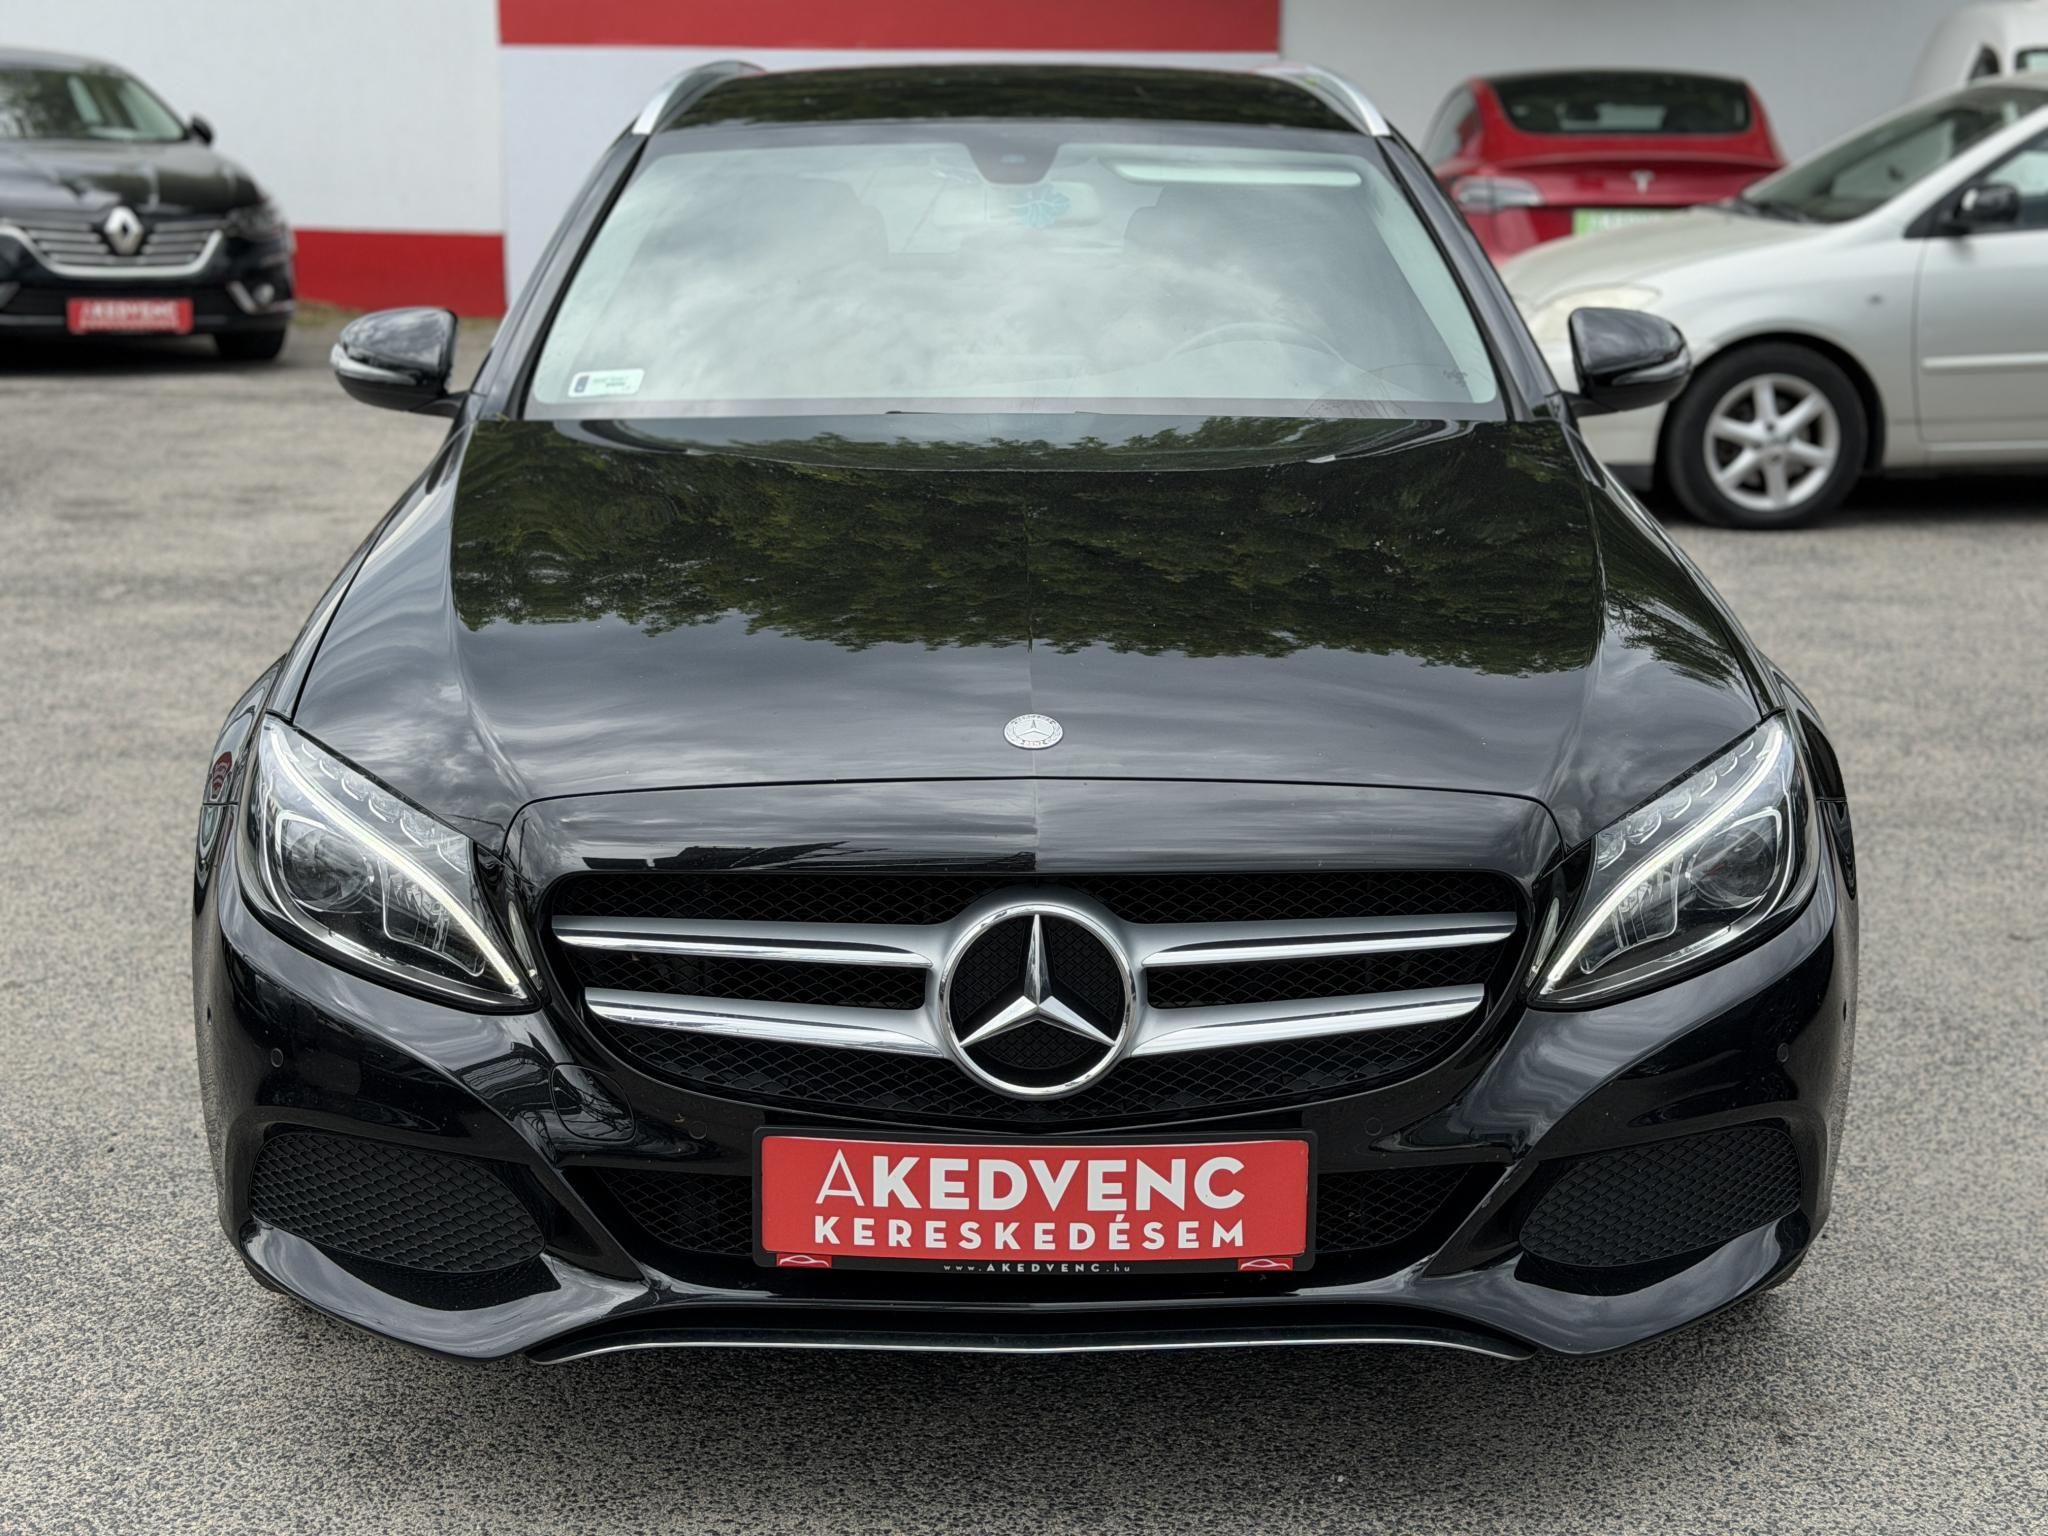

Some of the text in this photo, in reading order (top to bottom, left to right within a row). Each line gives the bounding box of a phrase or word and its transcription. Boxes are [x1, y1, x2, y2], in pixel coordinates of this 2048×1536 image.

[815, 1148, 1246, 1213] AKEDVENC
[814, 1213, 1244, 1251] KERESKEDÉSEM
[943, 1263, 1131, 1273] www.AKEDVENC.hu
